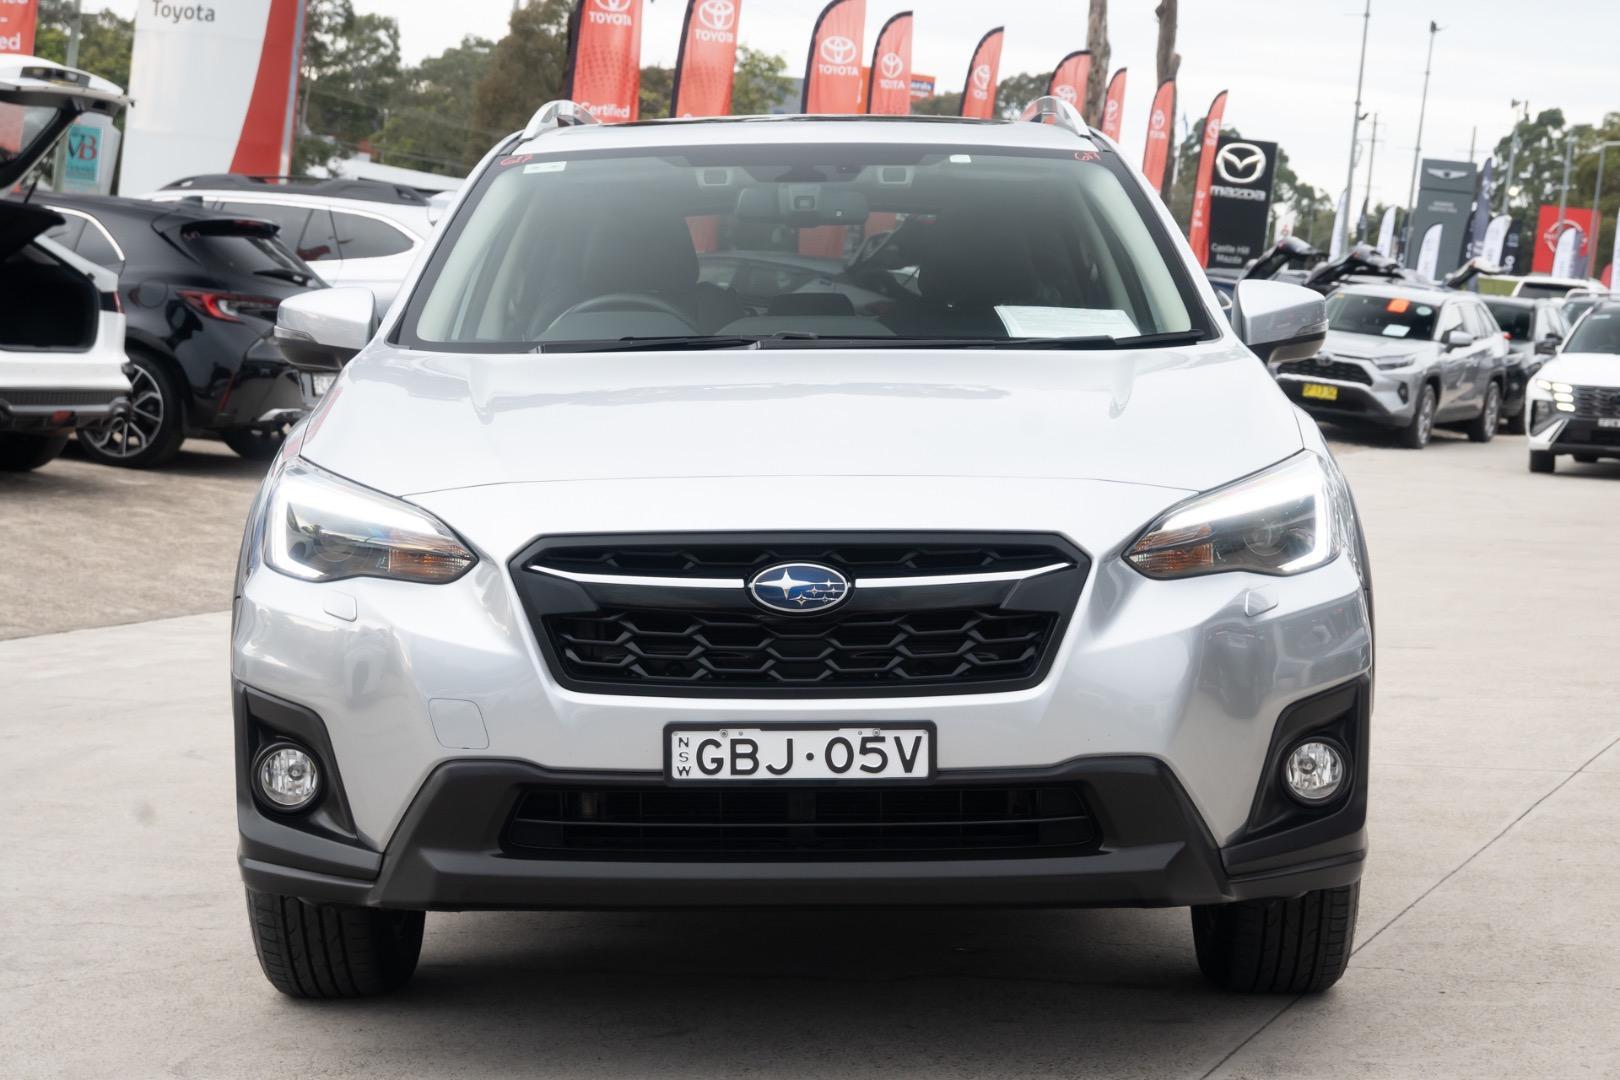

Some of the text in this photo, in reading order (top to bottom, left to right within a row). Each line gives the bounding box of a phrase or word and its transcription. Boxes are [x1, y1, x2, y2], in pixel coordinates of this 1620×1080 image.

[152, 0, 215, 24] Toyota
[695, 28, 734, 43] TOYO
[1210, 185, 1266, 201] mazda
